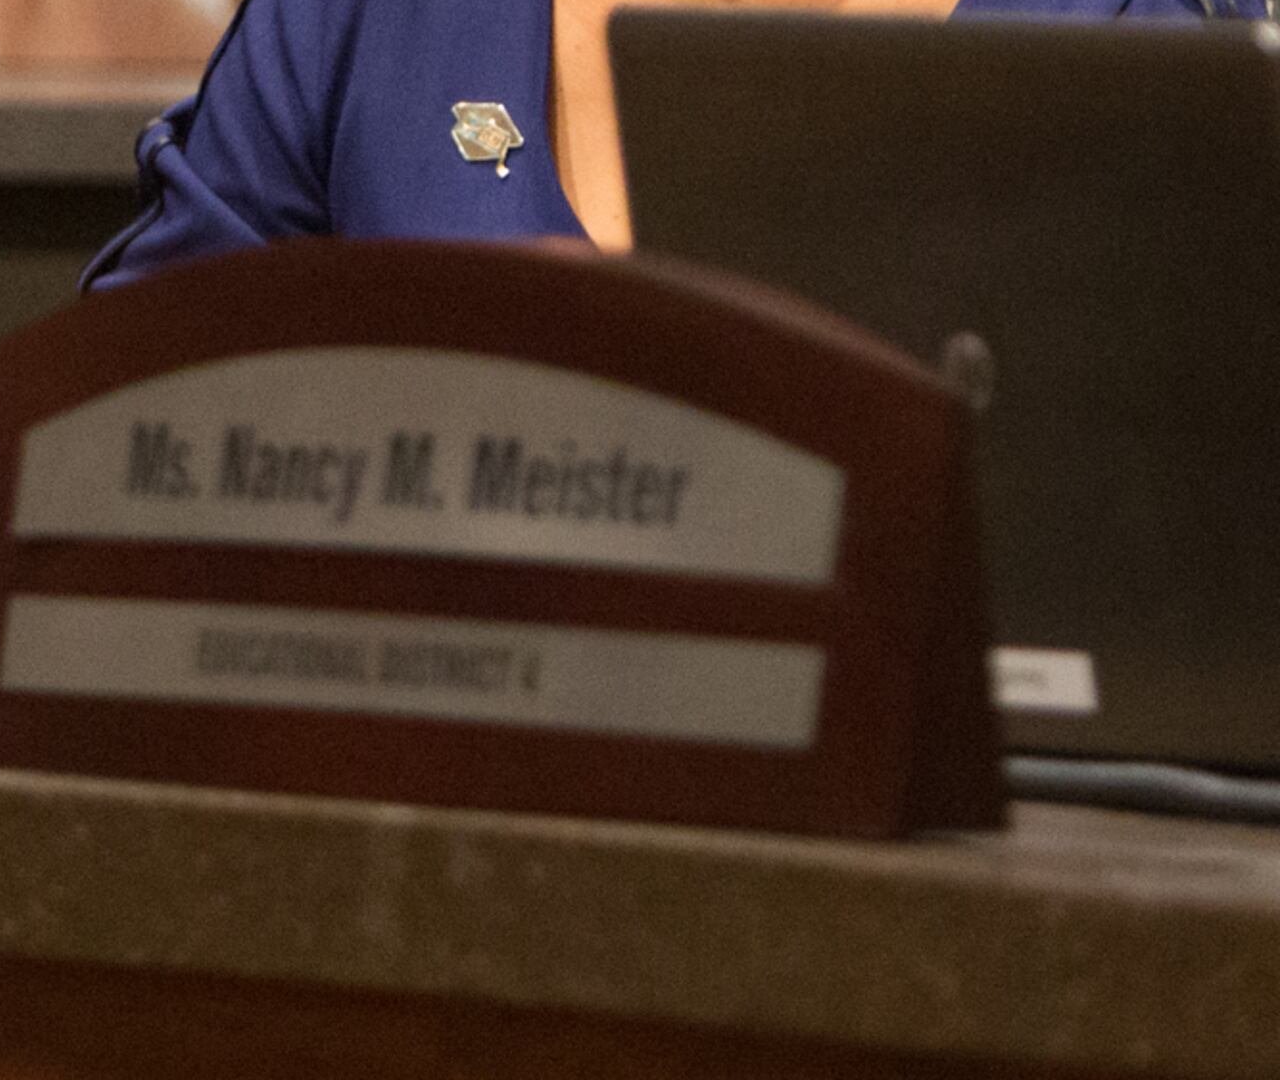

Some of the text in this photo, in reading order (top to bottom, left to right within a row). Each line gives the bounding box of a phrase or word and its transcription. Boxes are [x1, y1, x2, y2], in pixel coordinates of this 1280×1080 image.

[126, 421, 687, 527] Ms. Nancy M. Meister
